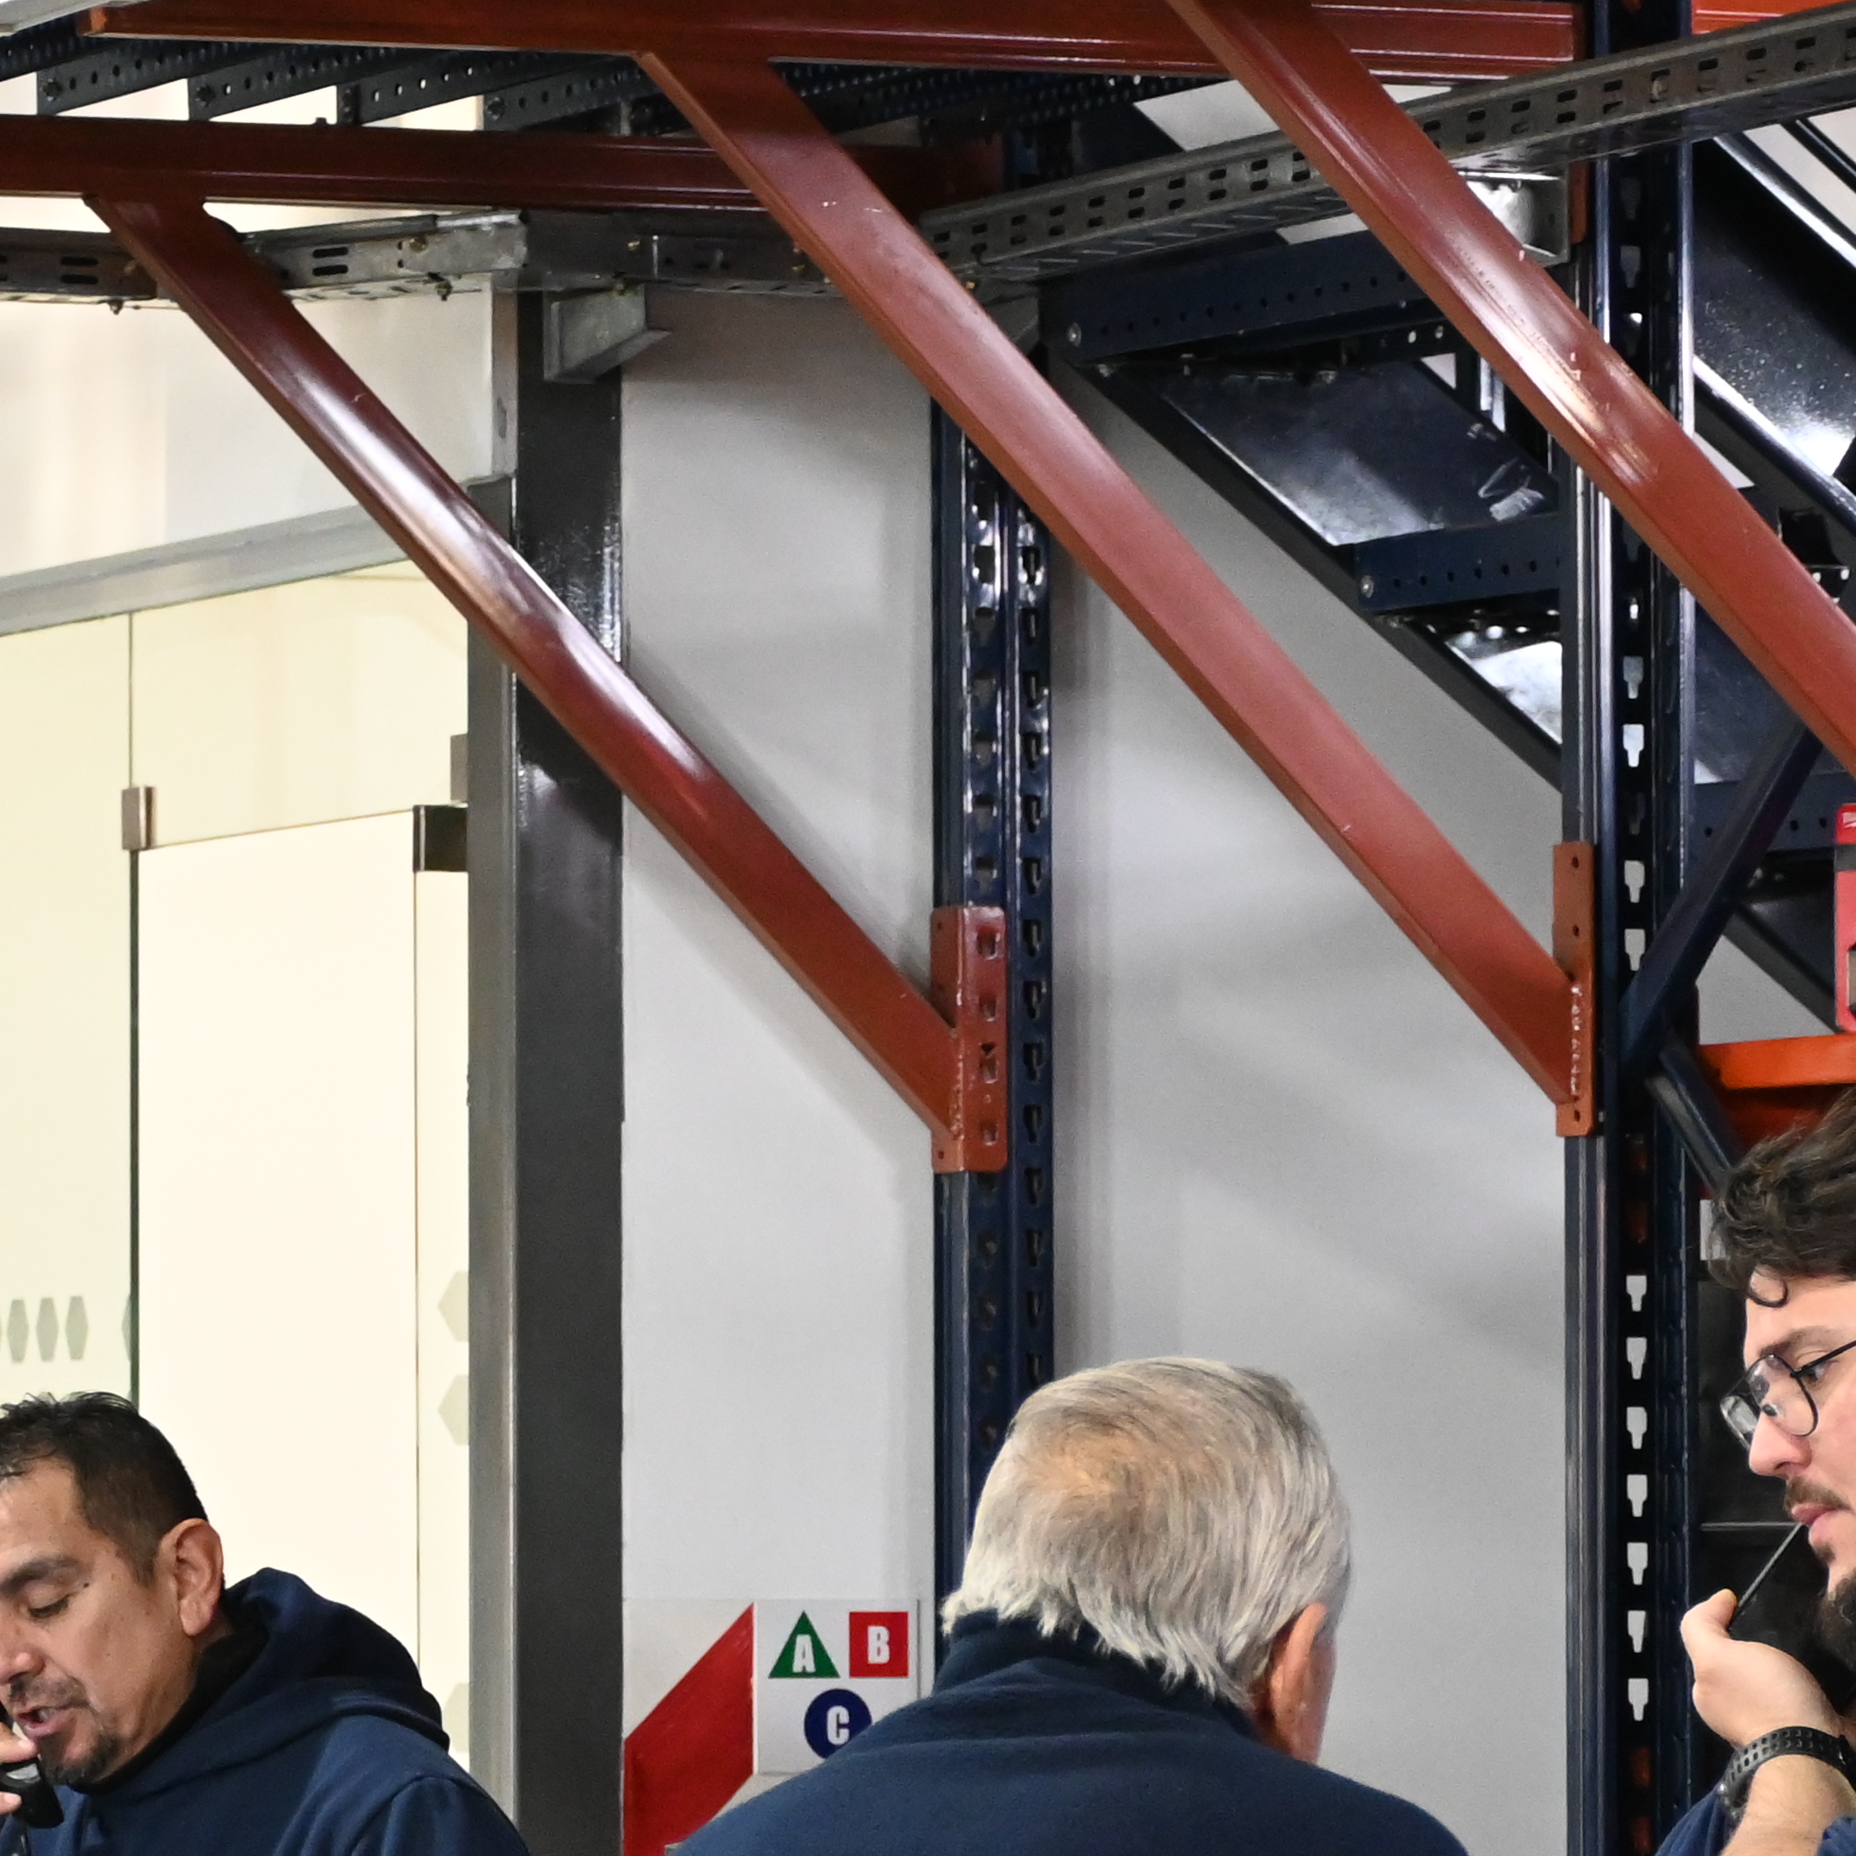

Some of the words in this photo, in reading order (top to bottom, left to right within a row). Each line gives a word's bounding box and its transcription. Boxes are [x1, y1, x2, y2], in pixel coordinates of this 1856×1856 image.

[792, 1634, 816, 1673] A
[867, 1625, 890, 1665] B
[826, 1705, 850, 1745] C
